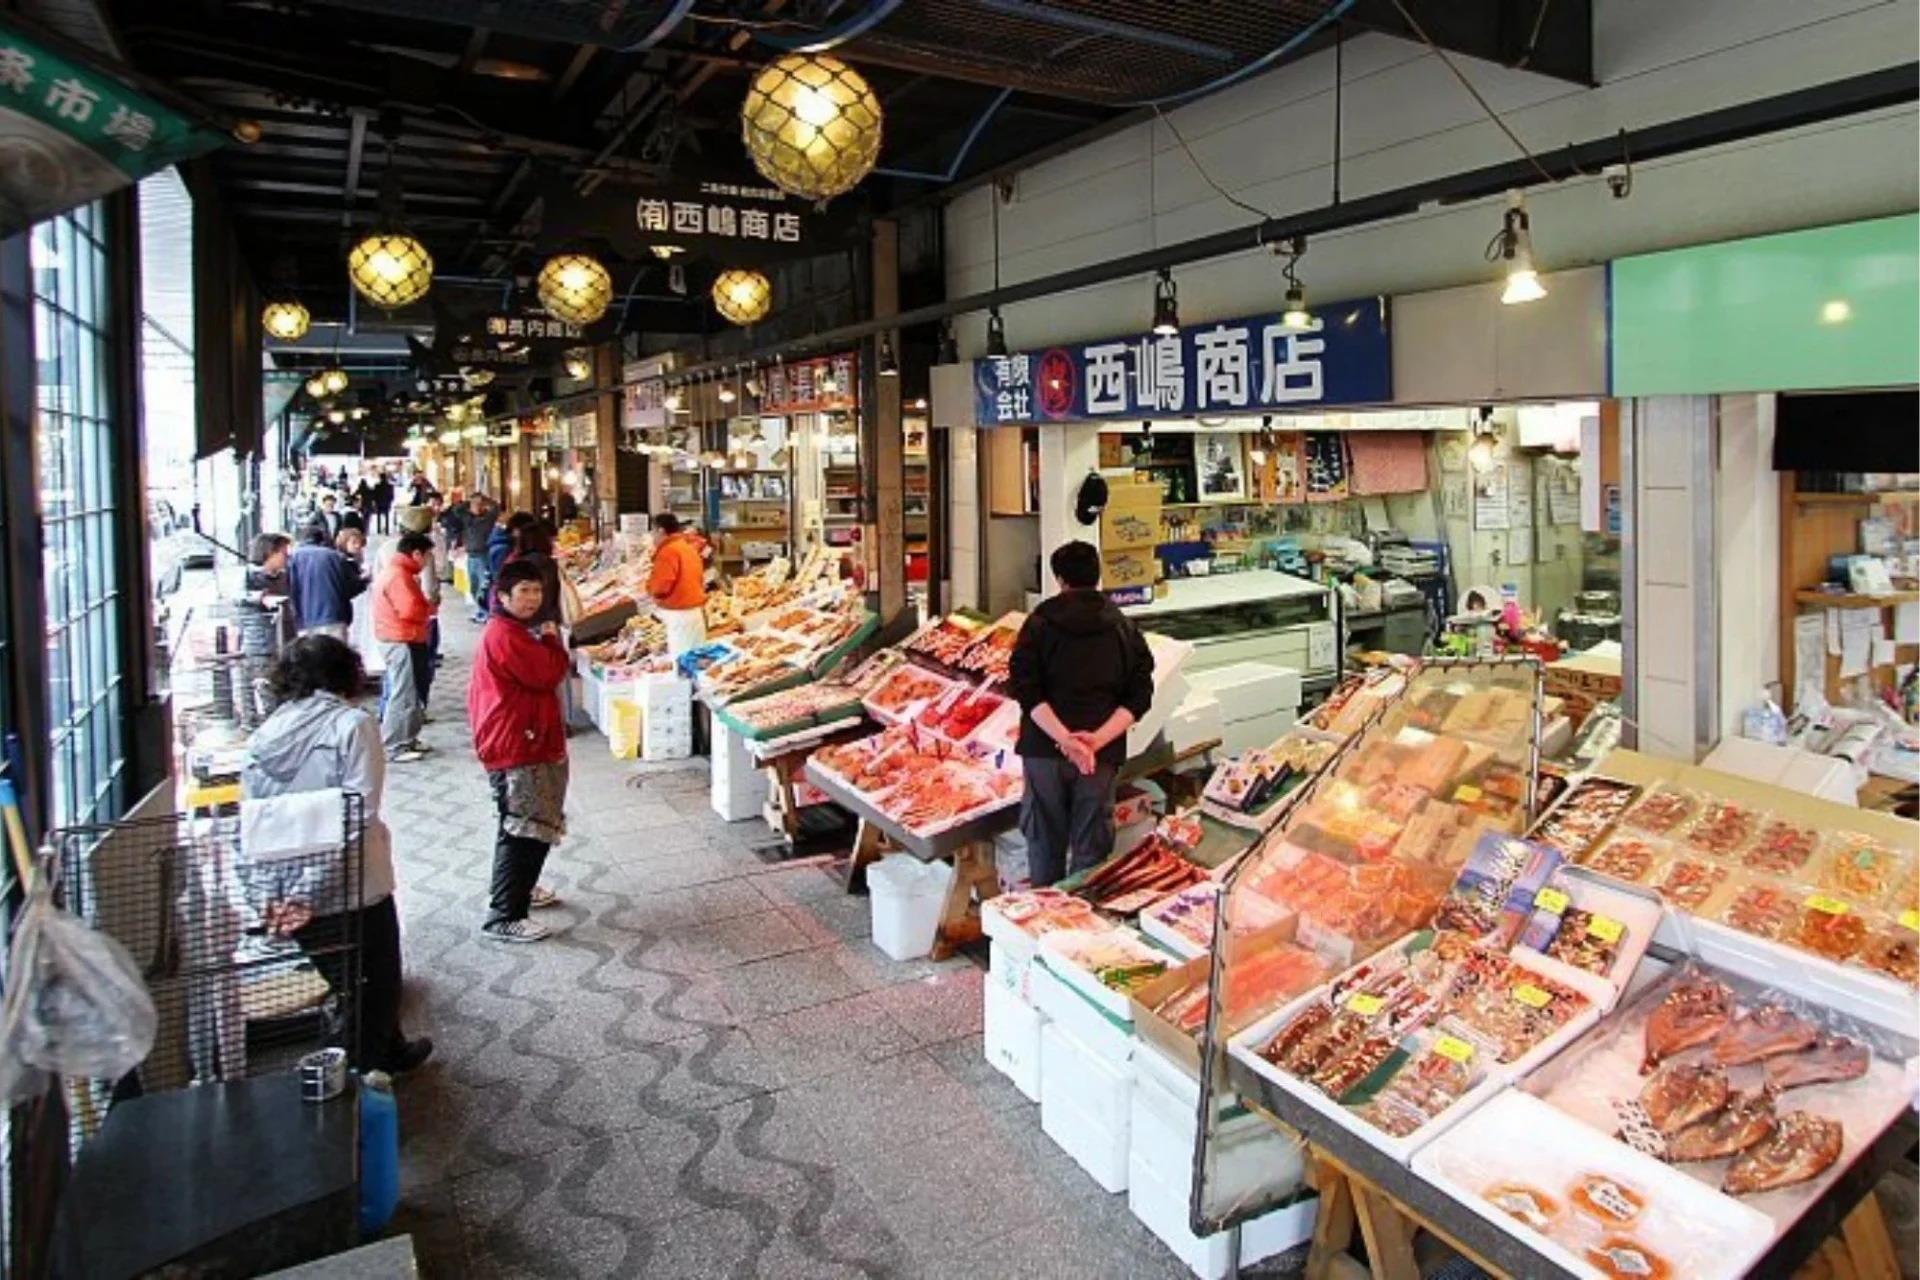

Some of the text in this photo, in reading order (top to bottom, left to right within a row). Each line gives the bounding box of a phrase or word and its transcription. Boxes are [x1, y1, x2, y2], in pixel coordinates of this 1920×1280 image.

[1084, 318, 1327, 414] 西嶋商店
[998, 388, 1032, 421] 会社
